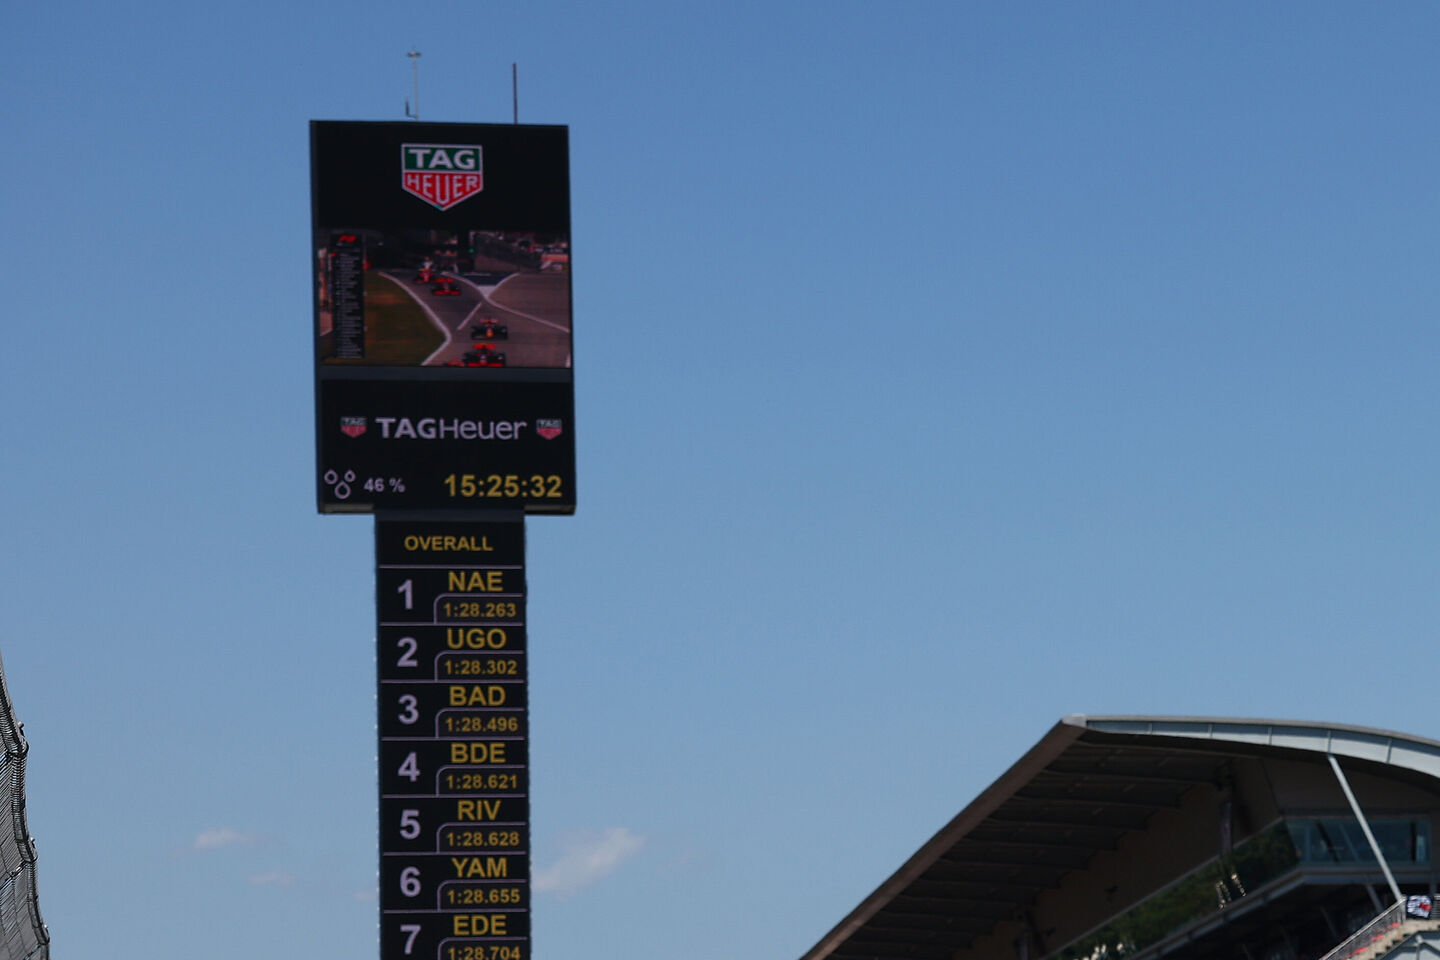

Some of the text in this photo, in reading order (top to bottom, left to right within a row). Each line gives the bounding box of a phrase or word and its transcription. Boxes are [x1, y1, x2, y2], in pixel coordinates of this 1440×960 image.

[409, 148, 476, 169] TAG
[406, 173, 479, 207] HEUER
[363, 477, 406, 493] 46 %
[443, 474, 563, 498] 15:25:32
[404, 535, 494, 551] OVERALL
[448, 571, 504, 592] NAE
[397, 579, 413, 610] 1
[443, 603, 517, 617] 1:28.263
[447, 628, 507, 649] UGO
[397, 637, 418, 667] 2
[444, 660, 517, 675] 1:28.302
[449, 685, 506, 706] BAD
[398, 694, 419, 725] 3
[445, 717, 519, 732] 1:28.496
[451, 743, 506, 763] BDE
[398, 752, 420, 782] 4
[446, 775, 518, 789] 1:28.621
[457, 800, 501, 821] RIV
[400, 809, 421, 840] 5
[446, 832, 520, 847] 1:28.628
[451, 857, 508, 878] YAM
[400, 866, 421, 897] 6
[447, 889, 521, 904] 1:28.655
[453, 915, 507, 935] EDE
[400, 924, 422, 955] 7
[448, 946, 521, 960] 1:28.704
